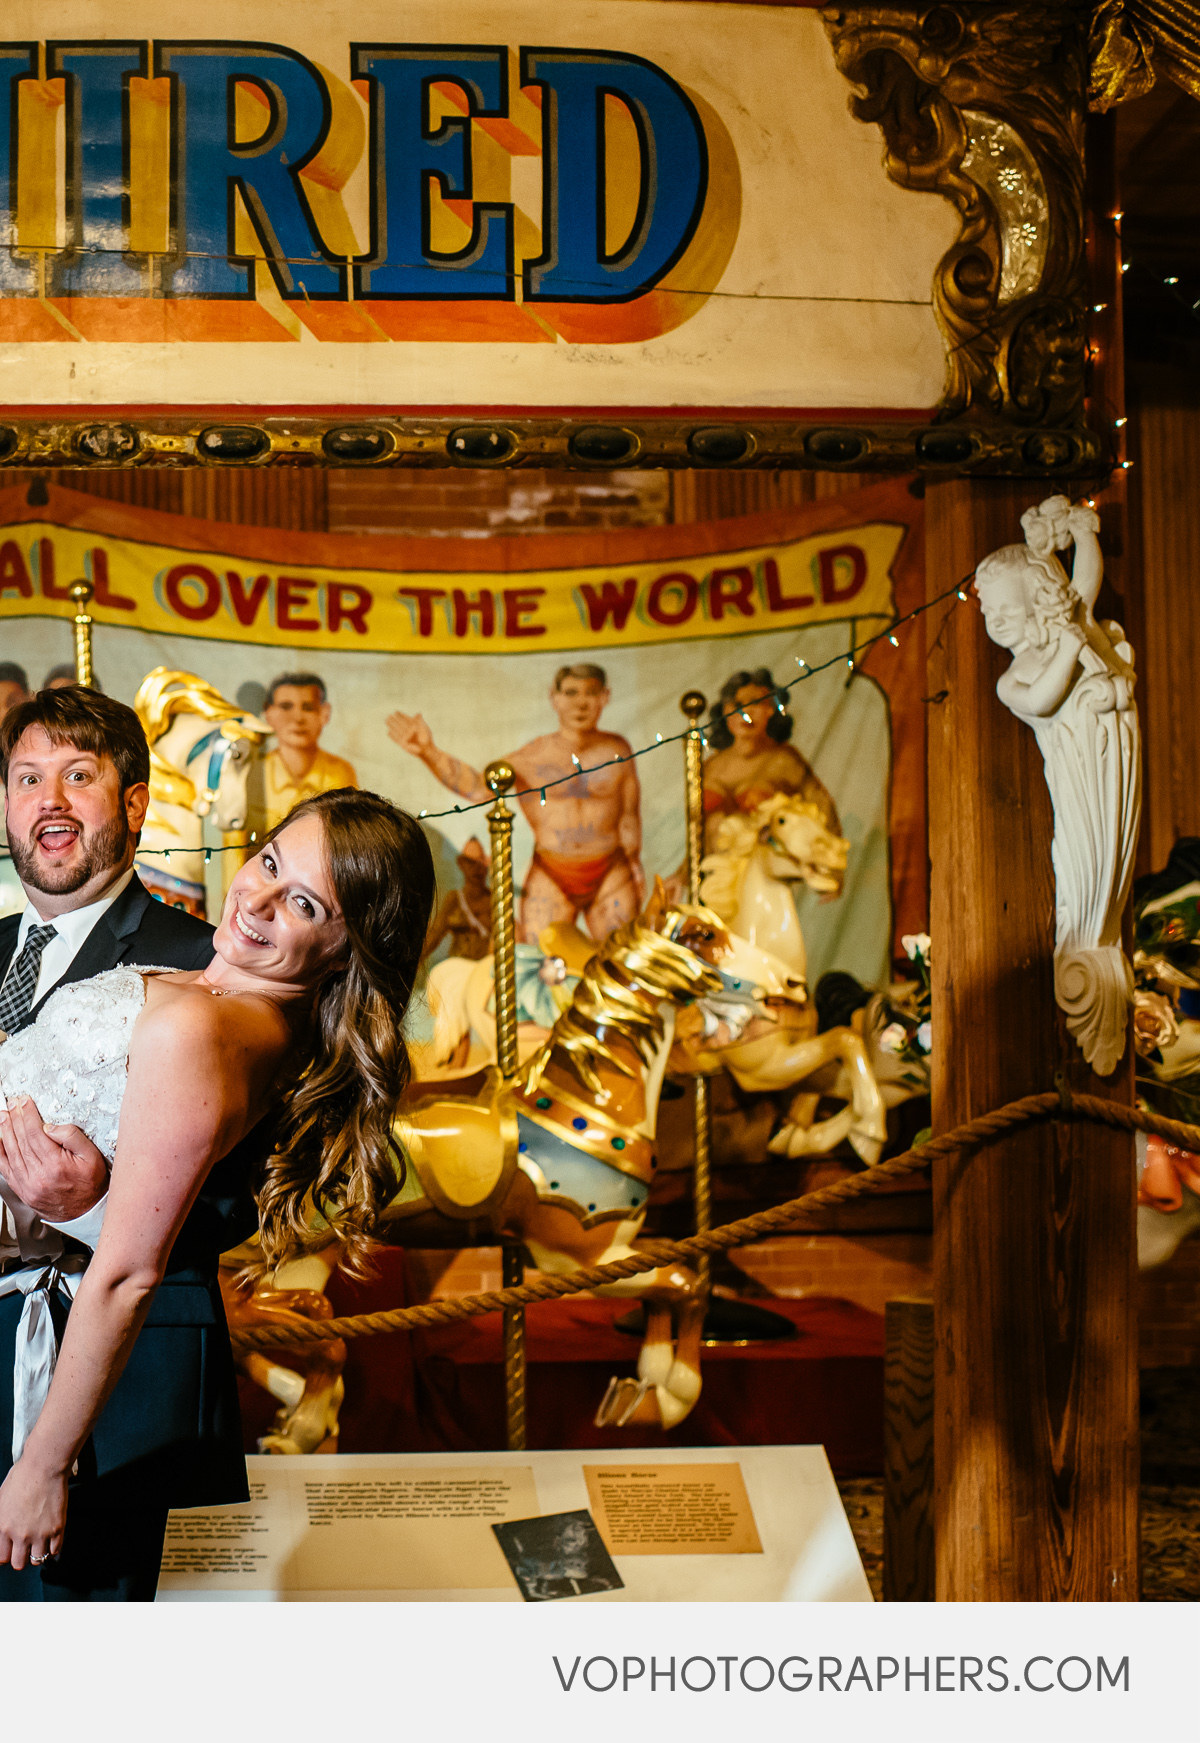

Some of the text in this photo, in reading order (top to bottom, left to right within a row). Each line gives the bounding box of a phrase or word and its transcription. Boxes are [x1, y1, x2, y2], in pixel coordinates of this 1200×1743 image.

[166, 564, 374, 635] OVER
[400, 587, 545, 638] THE
[580, 544, 867, 631] WORLD
